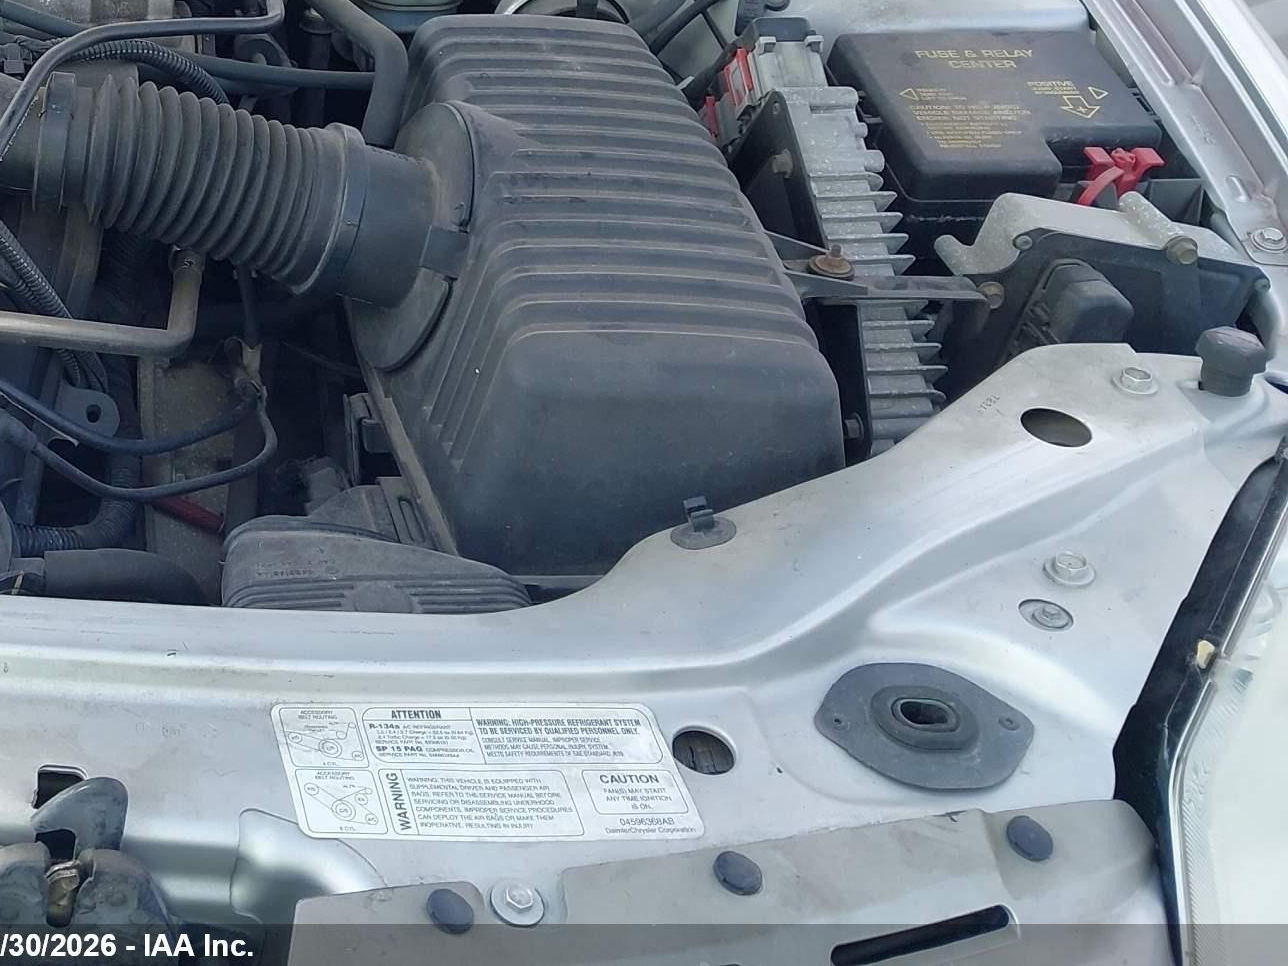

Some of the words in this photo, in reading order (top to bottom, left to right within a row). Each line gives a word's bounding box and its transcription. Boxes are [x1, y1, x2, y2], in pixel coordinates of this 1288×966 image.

[915, 50, 960, 58] FUSE
[964, 50, 977, 58] &
[981, 50, 1032, 58] RELAY
[948, 60, 1016, 68] CENTER
[392, 710, 442, 719] ATTENTION
[599, 774, 659, 784] CAUTION
[386, 772, 412, 831] WARNING
